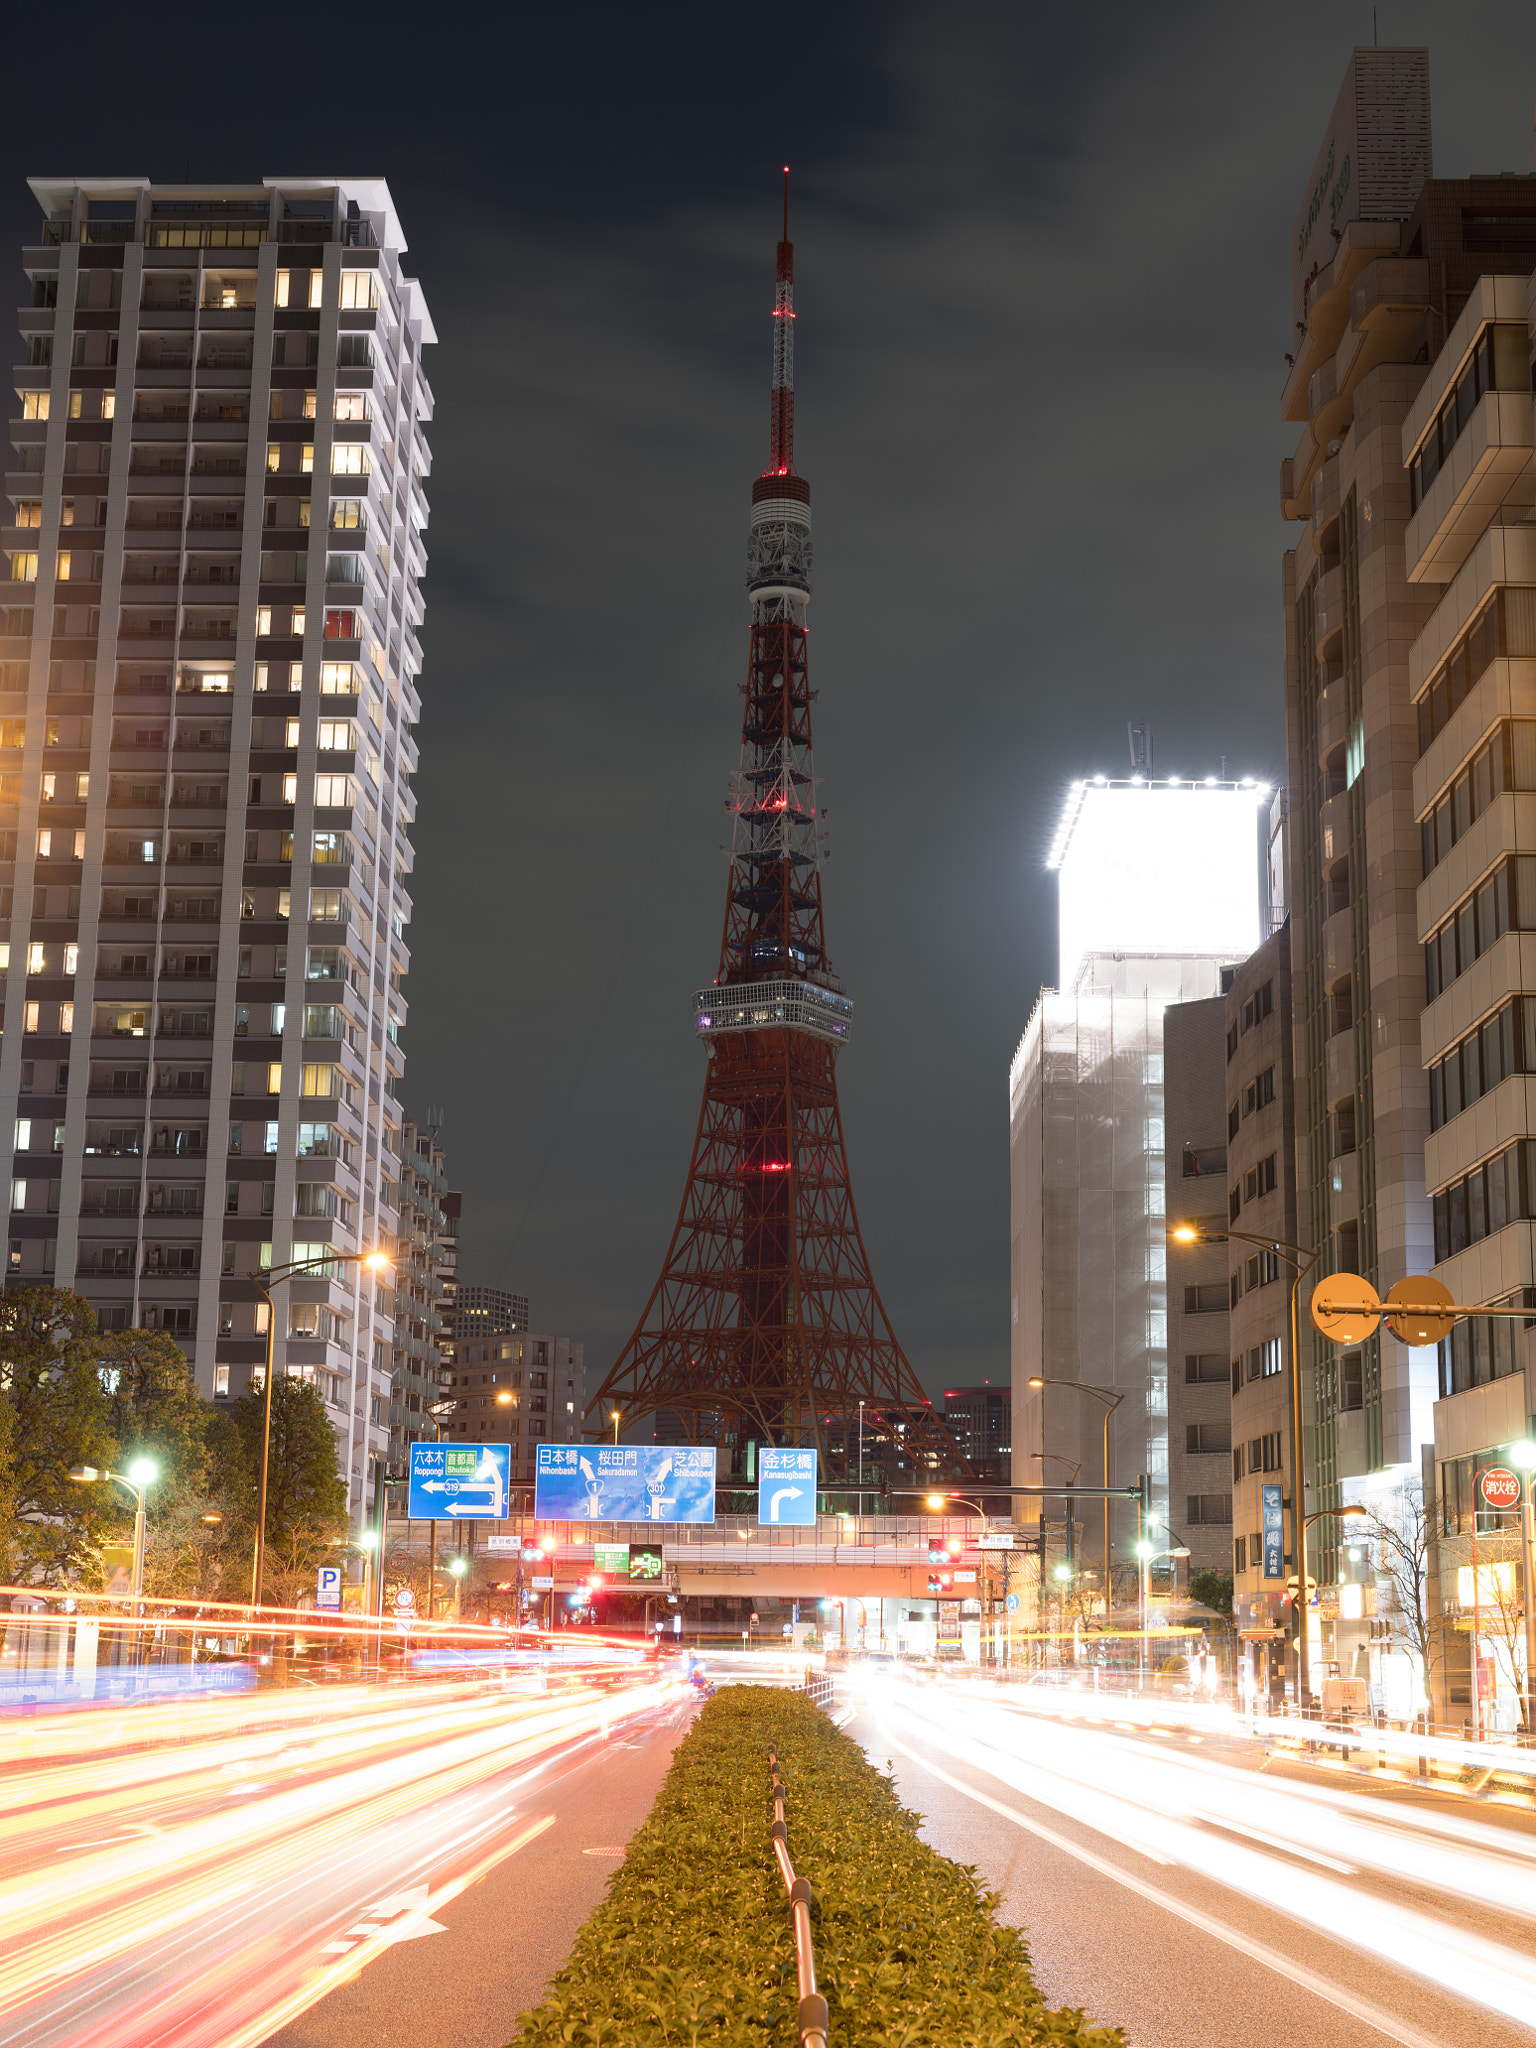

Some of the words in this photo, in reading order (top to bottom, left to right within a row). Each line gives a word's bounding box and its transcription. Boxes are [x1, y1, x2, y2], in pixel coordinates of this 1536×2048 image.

[414, 1450, 444, 1465] 六本木
[447, 1453, 476, 1465] 首都高
[540, 1449, 578, 1465] 日本橋
[598, 1450, 637, 1466] 桜田門
[674, 1451, 713, 1467] 芝公園
[764, 1453, 812, 1469] 金杉橋
[414, 1467, 444, 1477] Roppongi
[447, 1466, 475, 1474] Shutoko
[540, 1466, 577, 1475] Nihonbashi
[597, 1467, 638, 1476] Sakuradamon
[674, 1468, 713, 1477] Shibakoen
[764, 1470, 812, 1480] Kanasugibashi
[446, 1483, 458, 1491] 319
[592, 1482, 597, 1492] 1
[650, 1484, 663, 1493] 301
[1485, 1480, 1517, 1495] 消火栓
[1265, 1491, 1280, 1547] そば処
[322, 1571, 337, 1589] P
